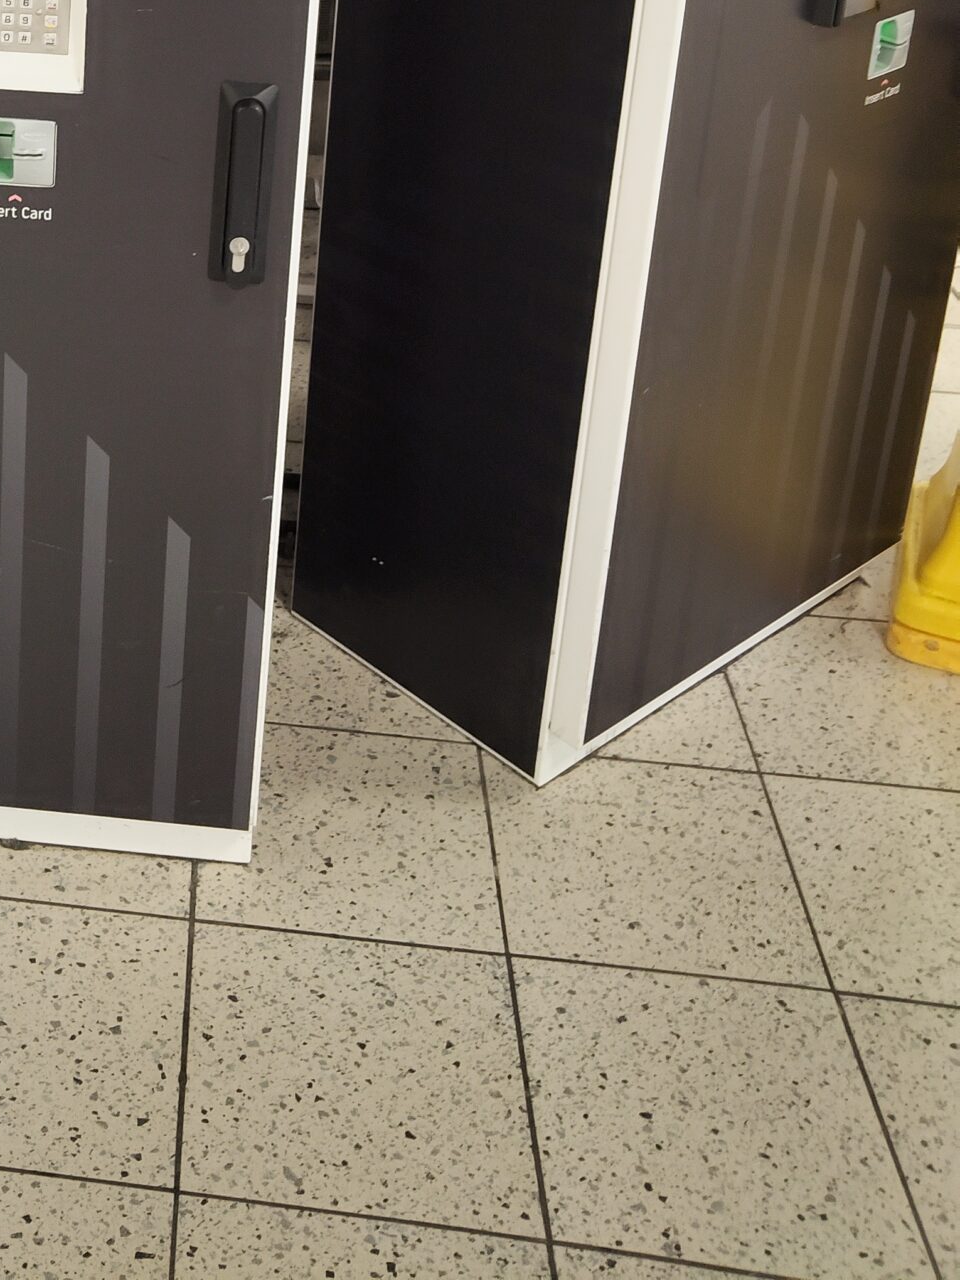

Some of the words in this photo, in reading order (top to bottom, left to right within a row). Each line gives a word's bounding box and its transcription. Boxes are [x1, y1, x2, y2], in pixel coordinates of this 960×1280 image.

[23, 0, 29, 7] 6
[3, 33, 10, 41] 0
[21, 207, 52, 221] Card
